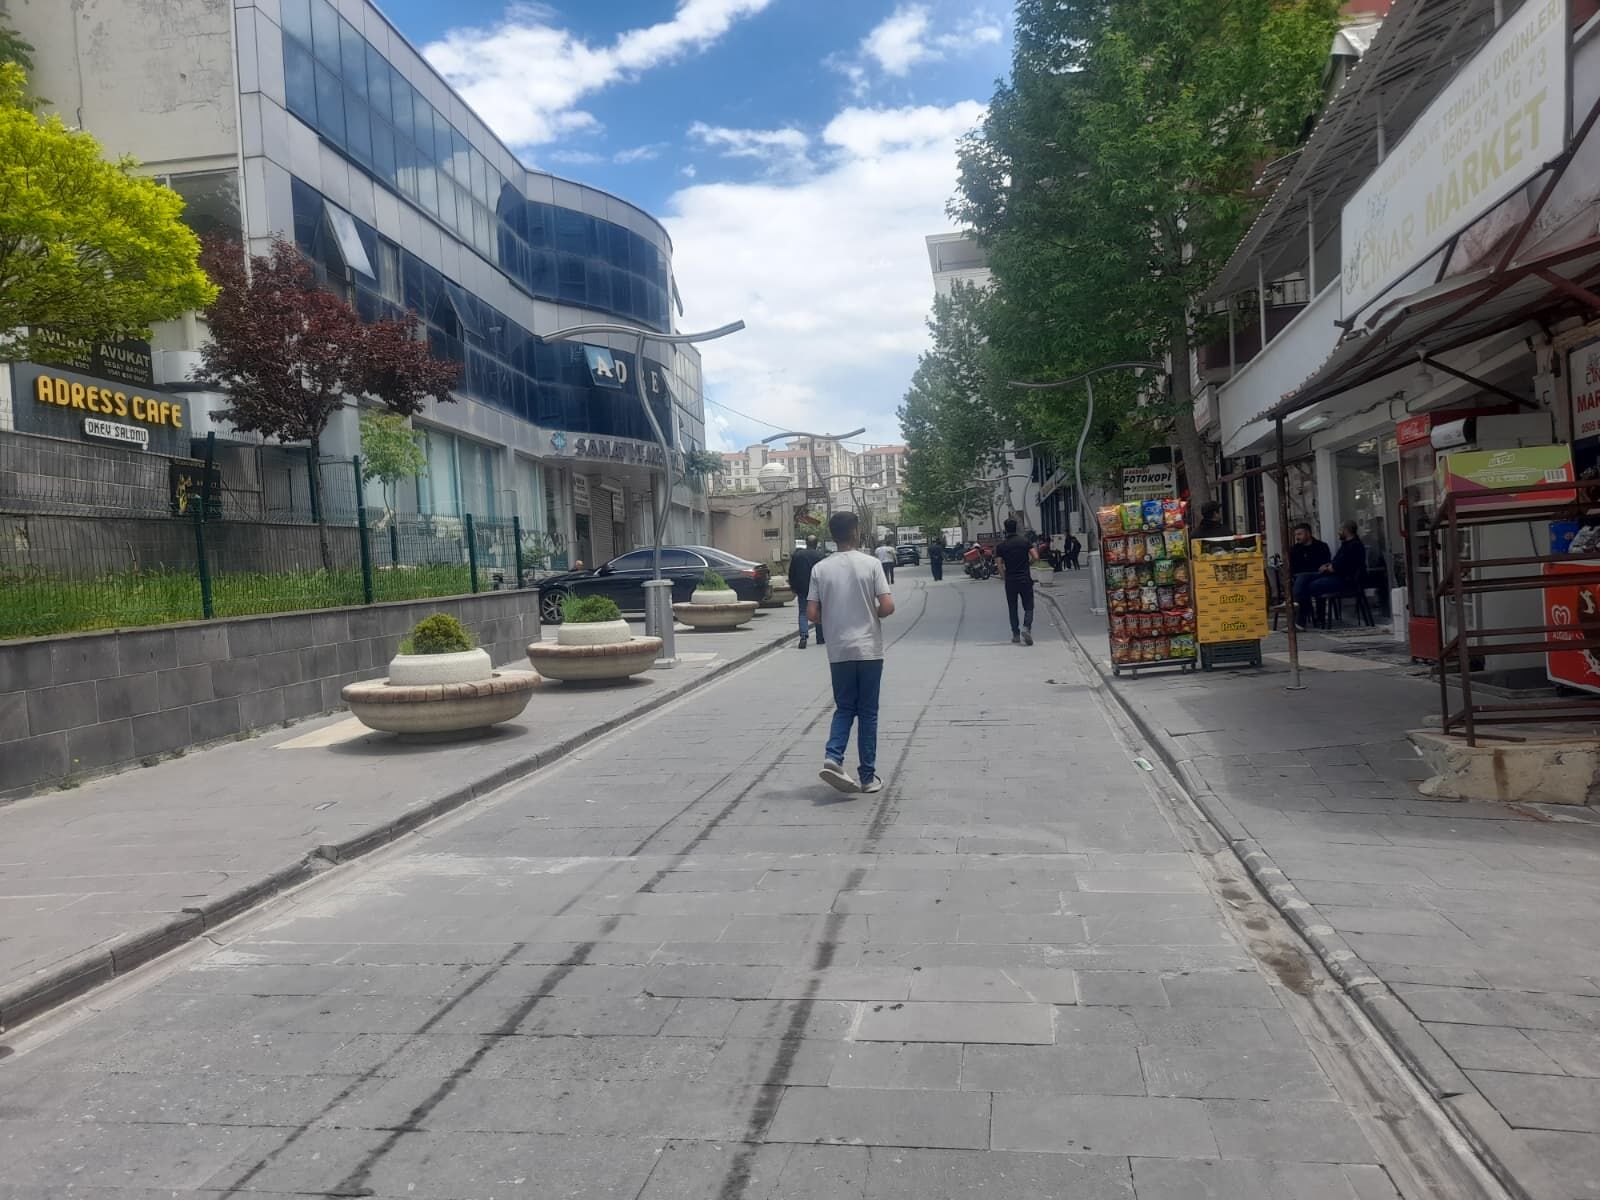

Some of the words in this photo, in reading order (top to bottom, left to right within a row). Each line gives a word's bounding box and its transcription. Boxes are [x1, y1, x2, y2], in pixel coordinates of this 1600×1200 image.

[1504, 70, 1521, 104] 16
[1528, 47, 1547, 85] 73
[1425, 90, 1548, 239] MARKET
[100, 344, 150, 368] AVUKAT
[37, 375, 128, 417] ADRESS
[132, 395, 182, 428] CAFE
[115, 425, 146, 442] SALONU
[1124, 473, 1171, 484] FOTOKOPİ
